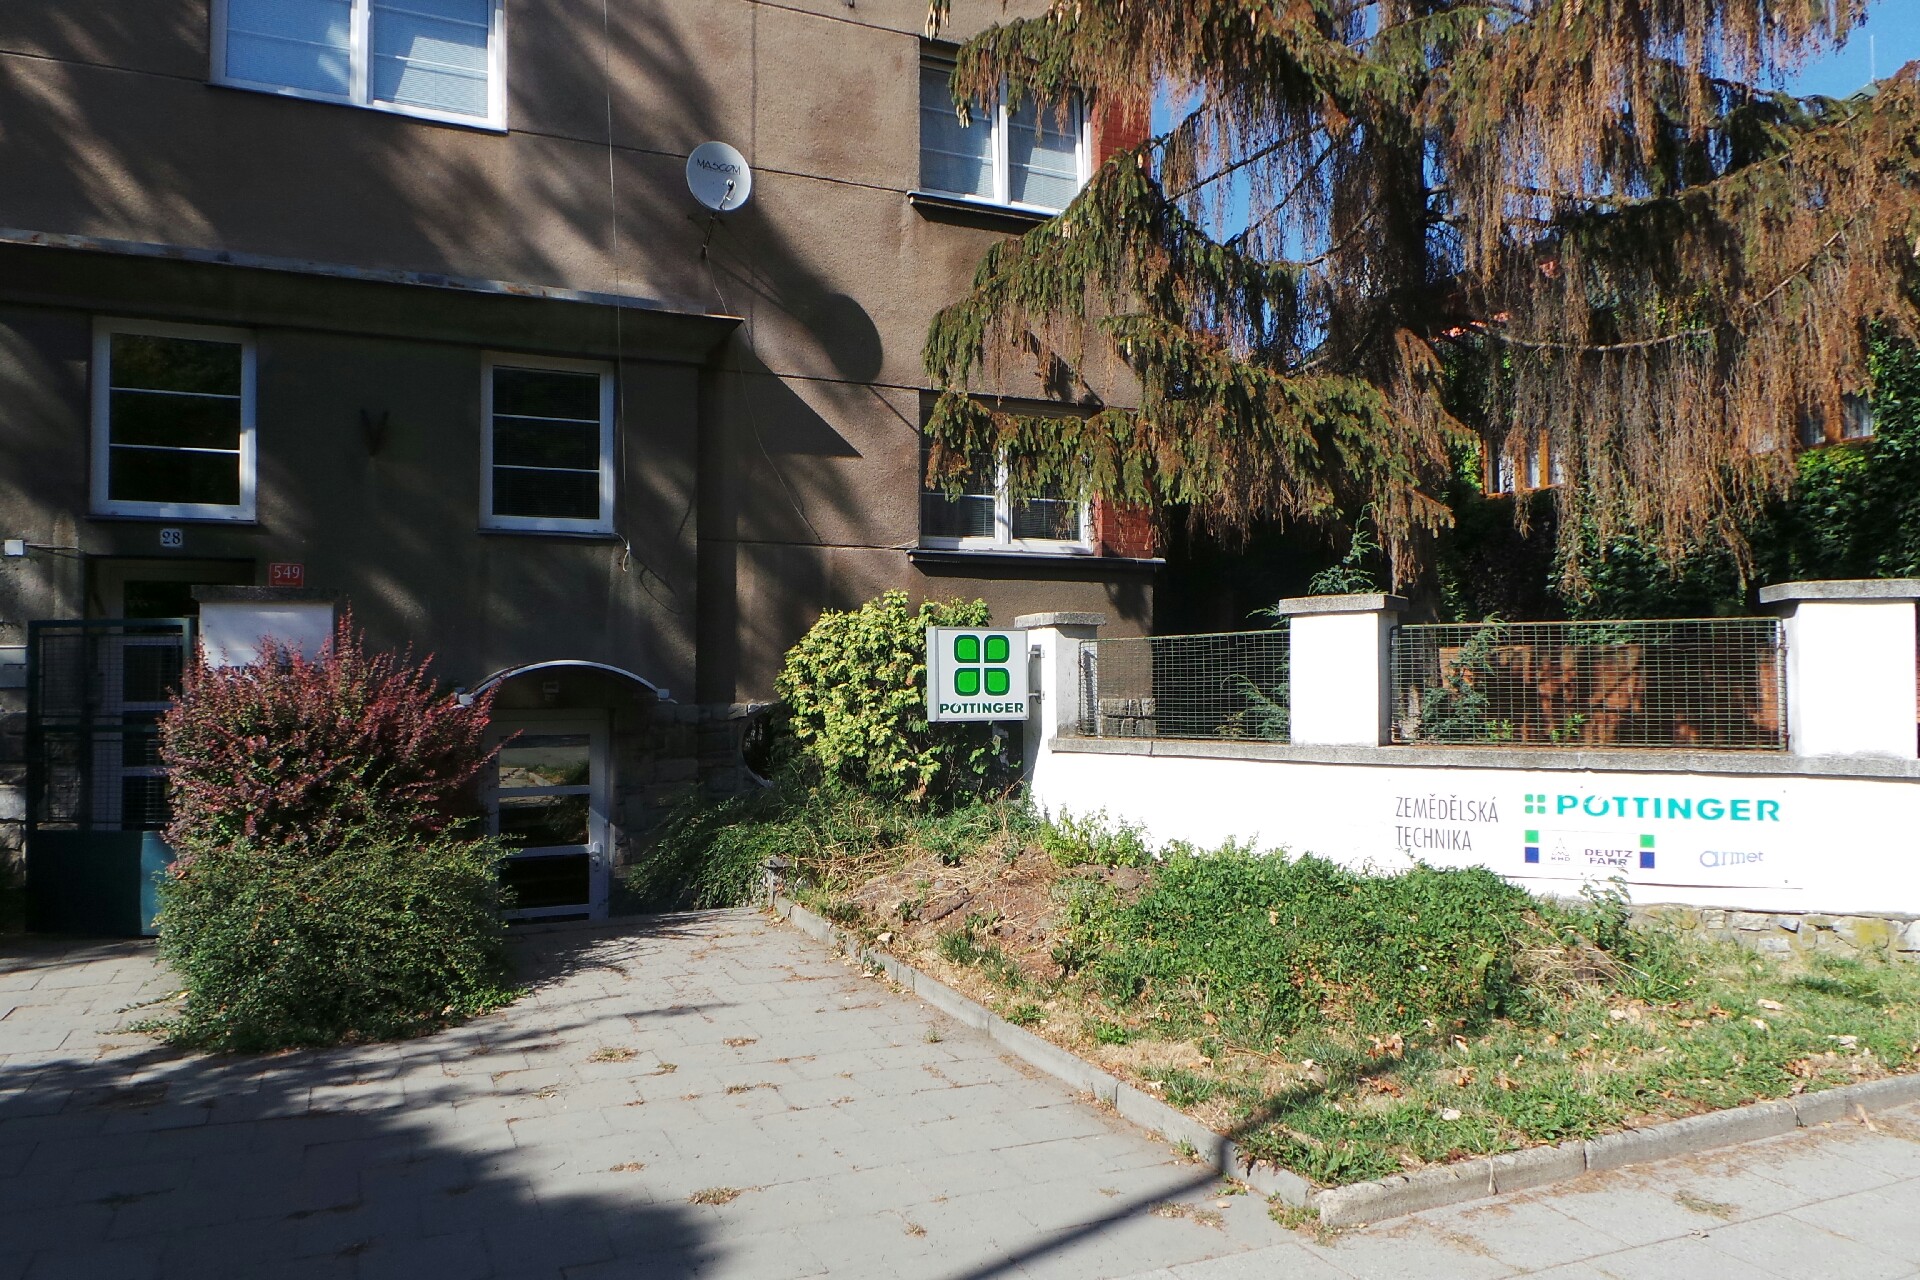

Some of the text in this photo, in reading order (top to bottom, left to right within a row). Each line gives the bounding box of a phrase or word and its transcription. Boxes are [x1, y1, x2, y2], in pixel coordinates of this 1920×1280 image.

[697, 159, 741, 175] MASCOM
[162, 531, 181, 544] 28
[274, 566, 300, 579] 549
[1395, 793, 1499, 823] ZEMĚDĚLSKÁ
[1395, 825, 1473, 851] TECHNIKA
[1584, 848, 1633, 858] DEUTZ
[1699, 850, 1764, 868] armet
[1588, 857, 1628, 866] FAHR
